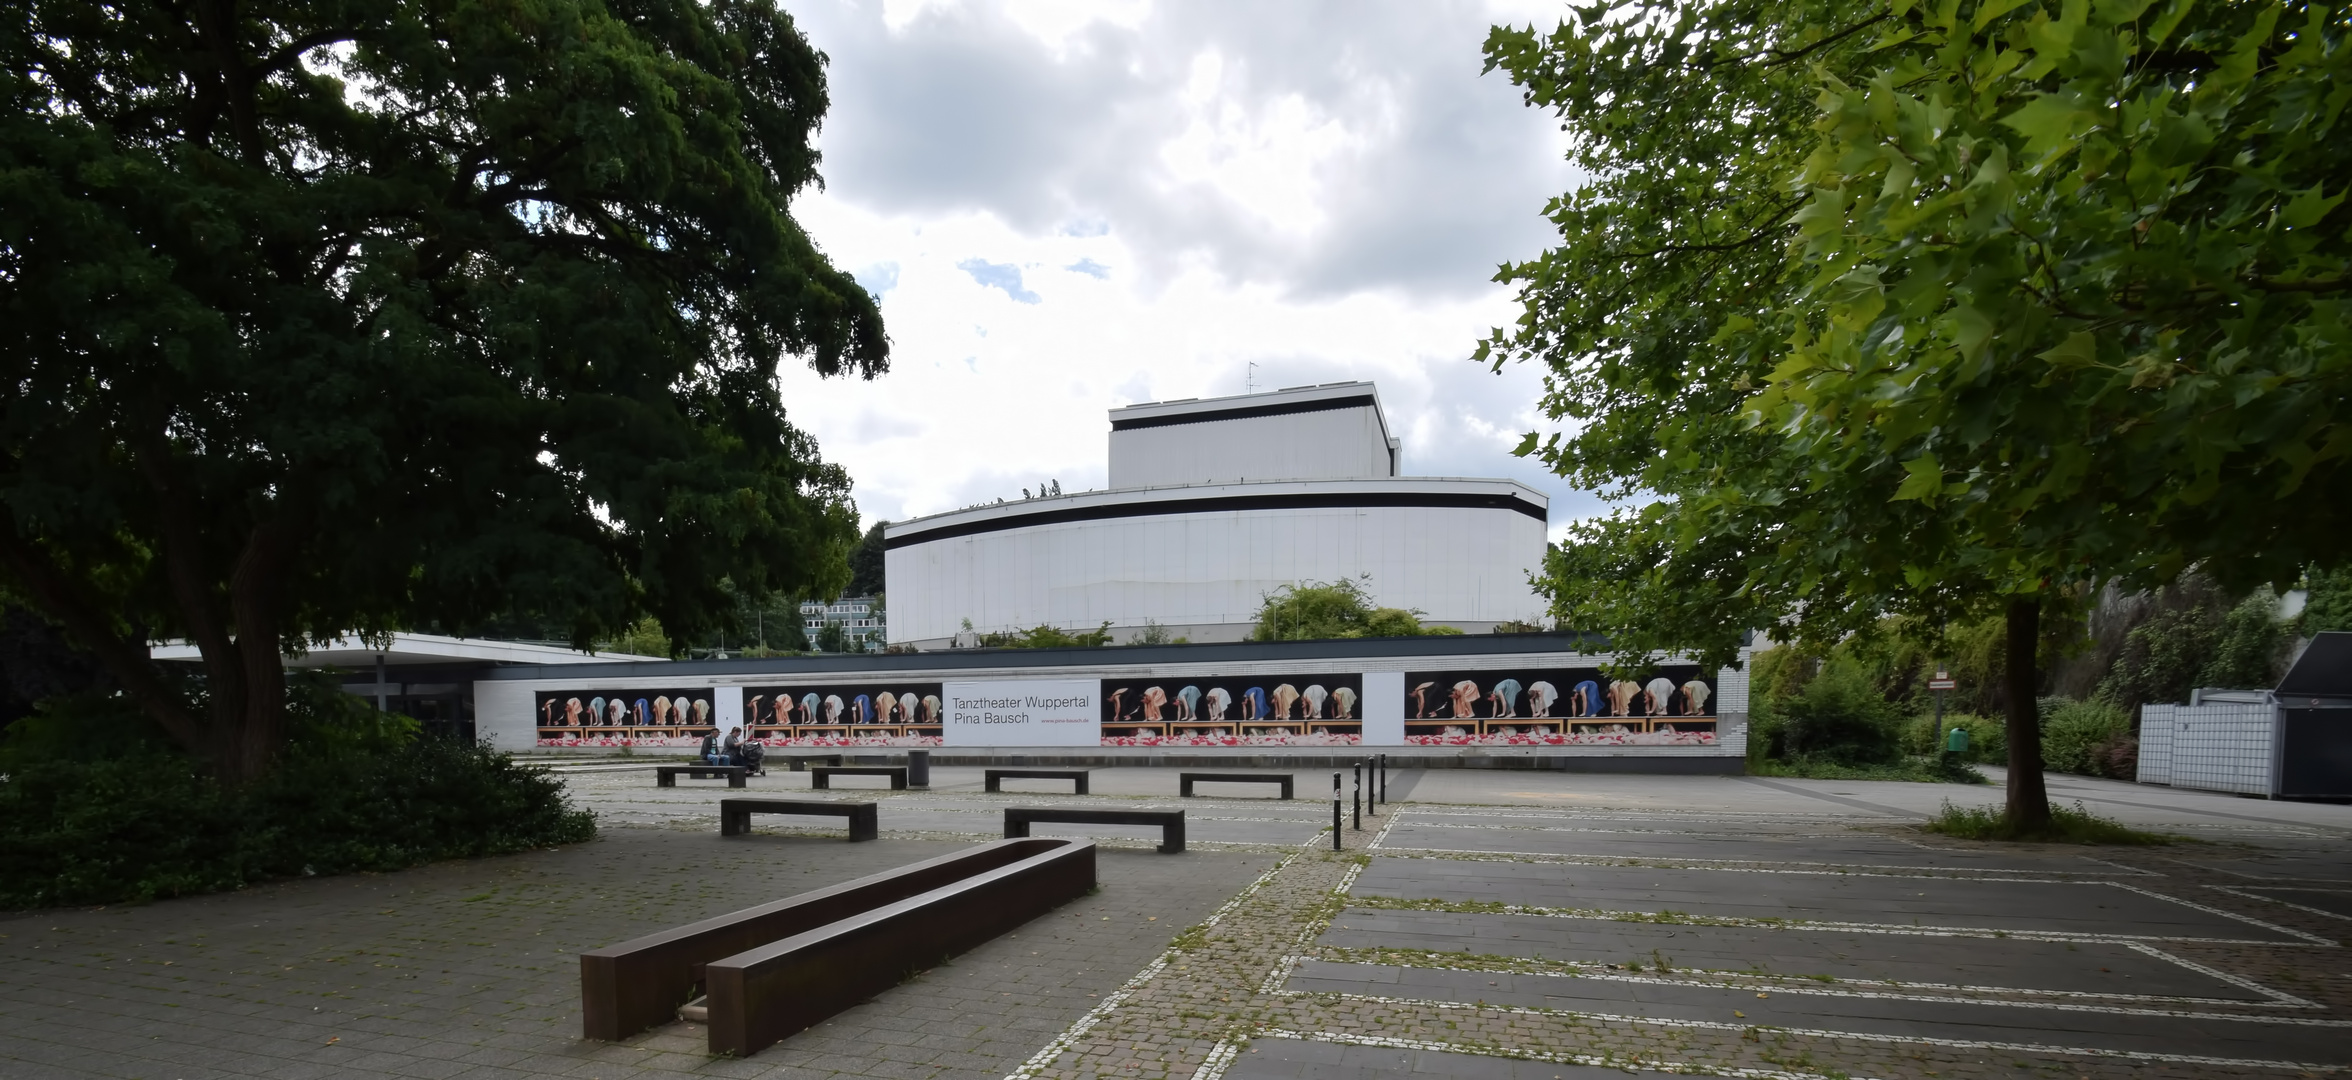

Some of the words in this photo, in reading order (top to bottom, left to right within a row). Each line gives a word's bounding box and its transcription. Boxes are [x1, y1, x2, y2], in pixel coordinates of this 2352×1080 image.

[952, 697, 1021, 709] Tanztheater
[1025, 695, 1089, 710] Wuppertal
[954, 713, 980, 724] Pina
[984, 712, 1029, 724] Bausch
